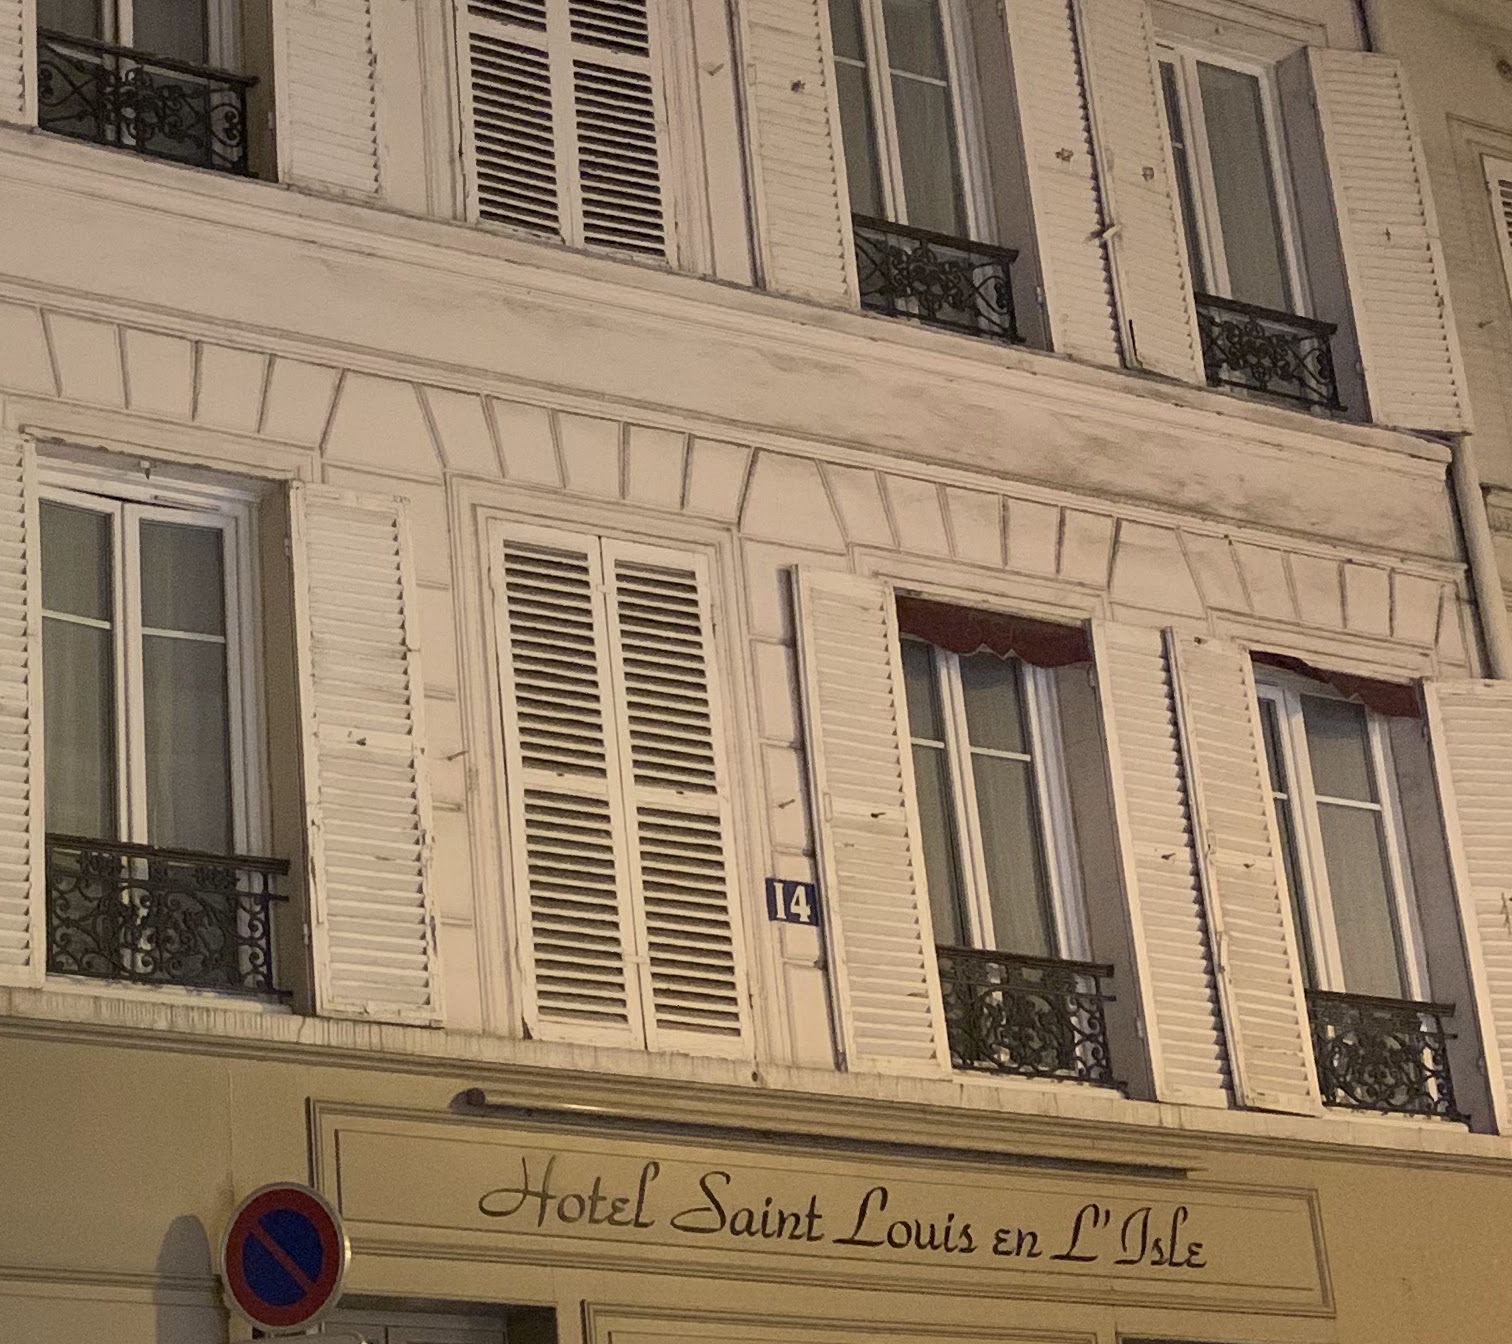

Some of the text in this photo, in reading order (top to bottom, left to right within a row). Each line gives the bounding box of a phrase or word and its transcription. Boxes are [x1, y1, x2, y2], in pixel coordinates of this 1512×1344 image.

[774, 882, 811, 922] 14
[479, 1154, 659, 1229] Hotel
[671, 1171, 826, 1244] Saint
[832, 1186, 976, 1255] Louis
[992, 1229, 1044, 1259] en
